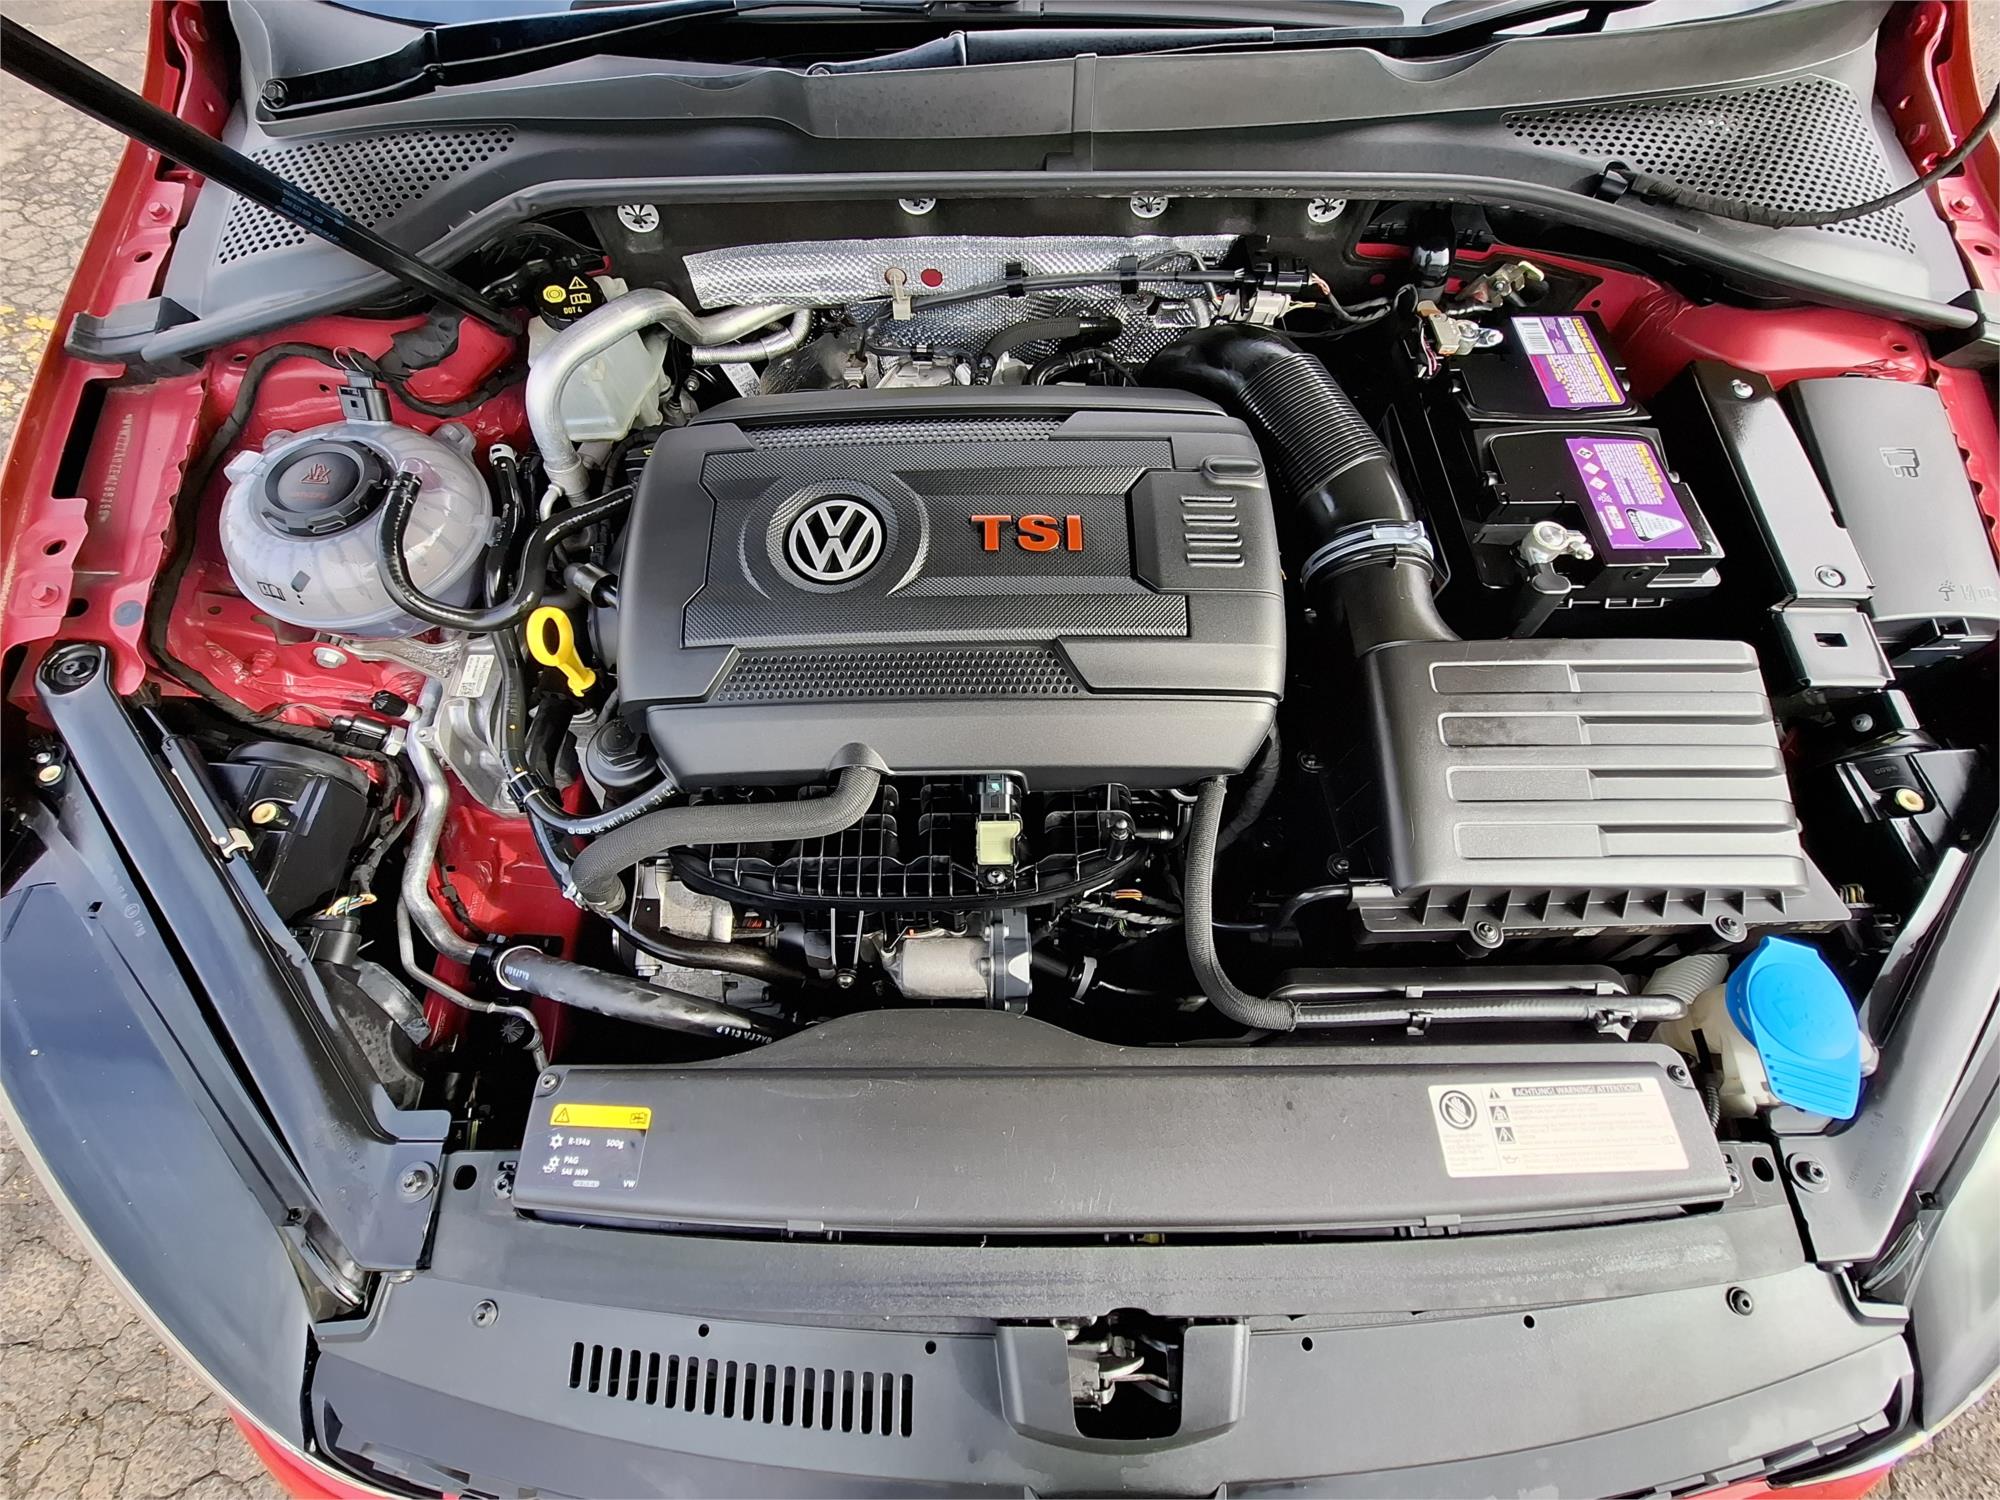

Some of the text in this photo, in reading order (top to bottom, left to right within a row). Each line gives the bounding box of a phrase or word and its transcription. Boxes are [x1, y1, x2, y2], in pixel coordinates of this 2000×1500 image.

[563, 306, 576, 314] DOT
[971, 514, 1083, 552] TSI
[789, 500, 882, 581] VW
[1515, 1087, 1554, 1097] ACHTUNG!
[1556, 1085, 1596, 1096] WARNING!
[606, 1138, 624, 1150] 500g
[563, 1155, 579, 1165] PAG
[561, 1167, 574, 1176] SAE
[623, 1179, 636, 1188] VW
